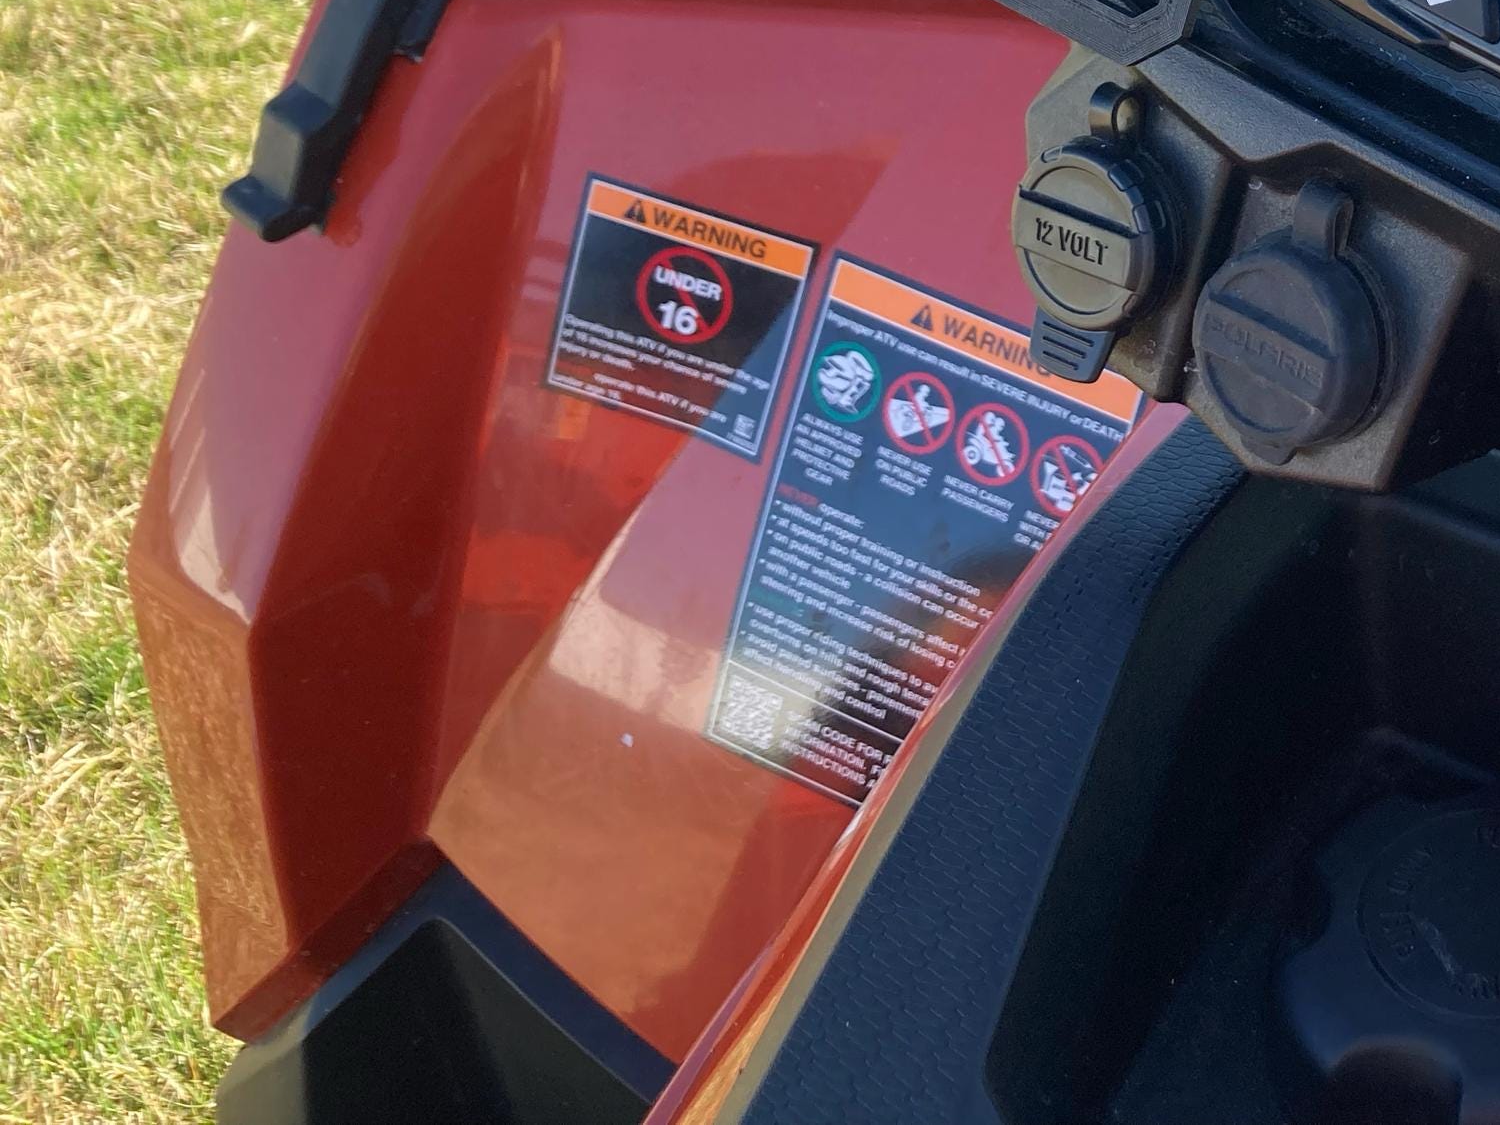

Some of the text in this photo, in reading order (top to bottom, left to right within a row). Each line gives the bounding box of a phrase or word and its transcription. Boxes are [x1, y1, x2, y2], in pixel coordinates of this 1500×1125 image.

[651, 206, 768, 260] WARNING
[1035, 216, 1109, 266] 12 VOLT
[652, 263, 723, 302] UNDER
[653, 296, 701, 338] 16
[872, 328, 899, 349] ATV
[897, 341, 918, 356] use
[917, 349, 938, 365] can
[981, 374, 1027, 403] SEVERE
[1025, 392, 1071, 421] INJURY
[977, 488, 1015, 512] CARRY
[809, 563, 852, 590] vehicle
[820, 520, 860, 546] proper
[858, 535, 905, 566] training
[902, 557, 919, 571] or
[917, 561, 982, 598] instruction
[828, 539, 850, 557] too
[871, 557, 890, 574] for
[887, 567, 915, 588] your
[913, 577, 944, 598] skills
[942, 591, 958, 605] or
[956, 595, 979, 613] the
[787, 536, 825, 562] public
[822, 552, 858, 576] roads
[871, 574, 923, 605] collision
[920, 598, 945, 616] can
[944, 608, 979, 631] occur
[795, 575, 855, 611] passenger
[859, 603, 926, 642] passengers
[844, 644, 910, 683] techniques
[907, 673, 923, 689] to
[894, 634, 910, 650] of
[908, 641, 946, 668] losing
[841, 660, 867, 679] and
[864, 670, 902, 697] rough
[900, 686, 930, 707] terra
[843, 692, 887, 720] control
[865, 688, 921, 721] pavemen
[820, 724, 858, 750] CODE
[854, 740, 883, 762] FOR
